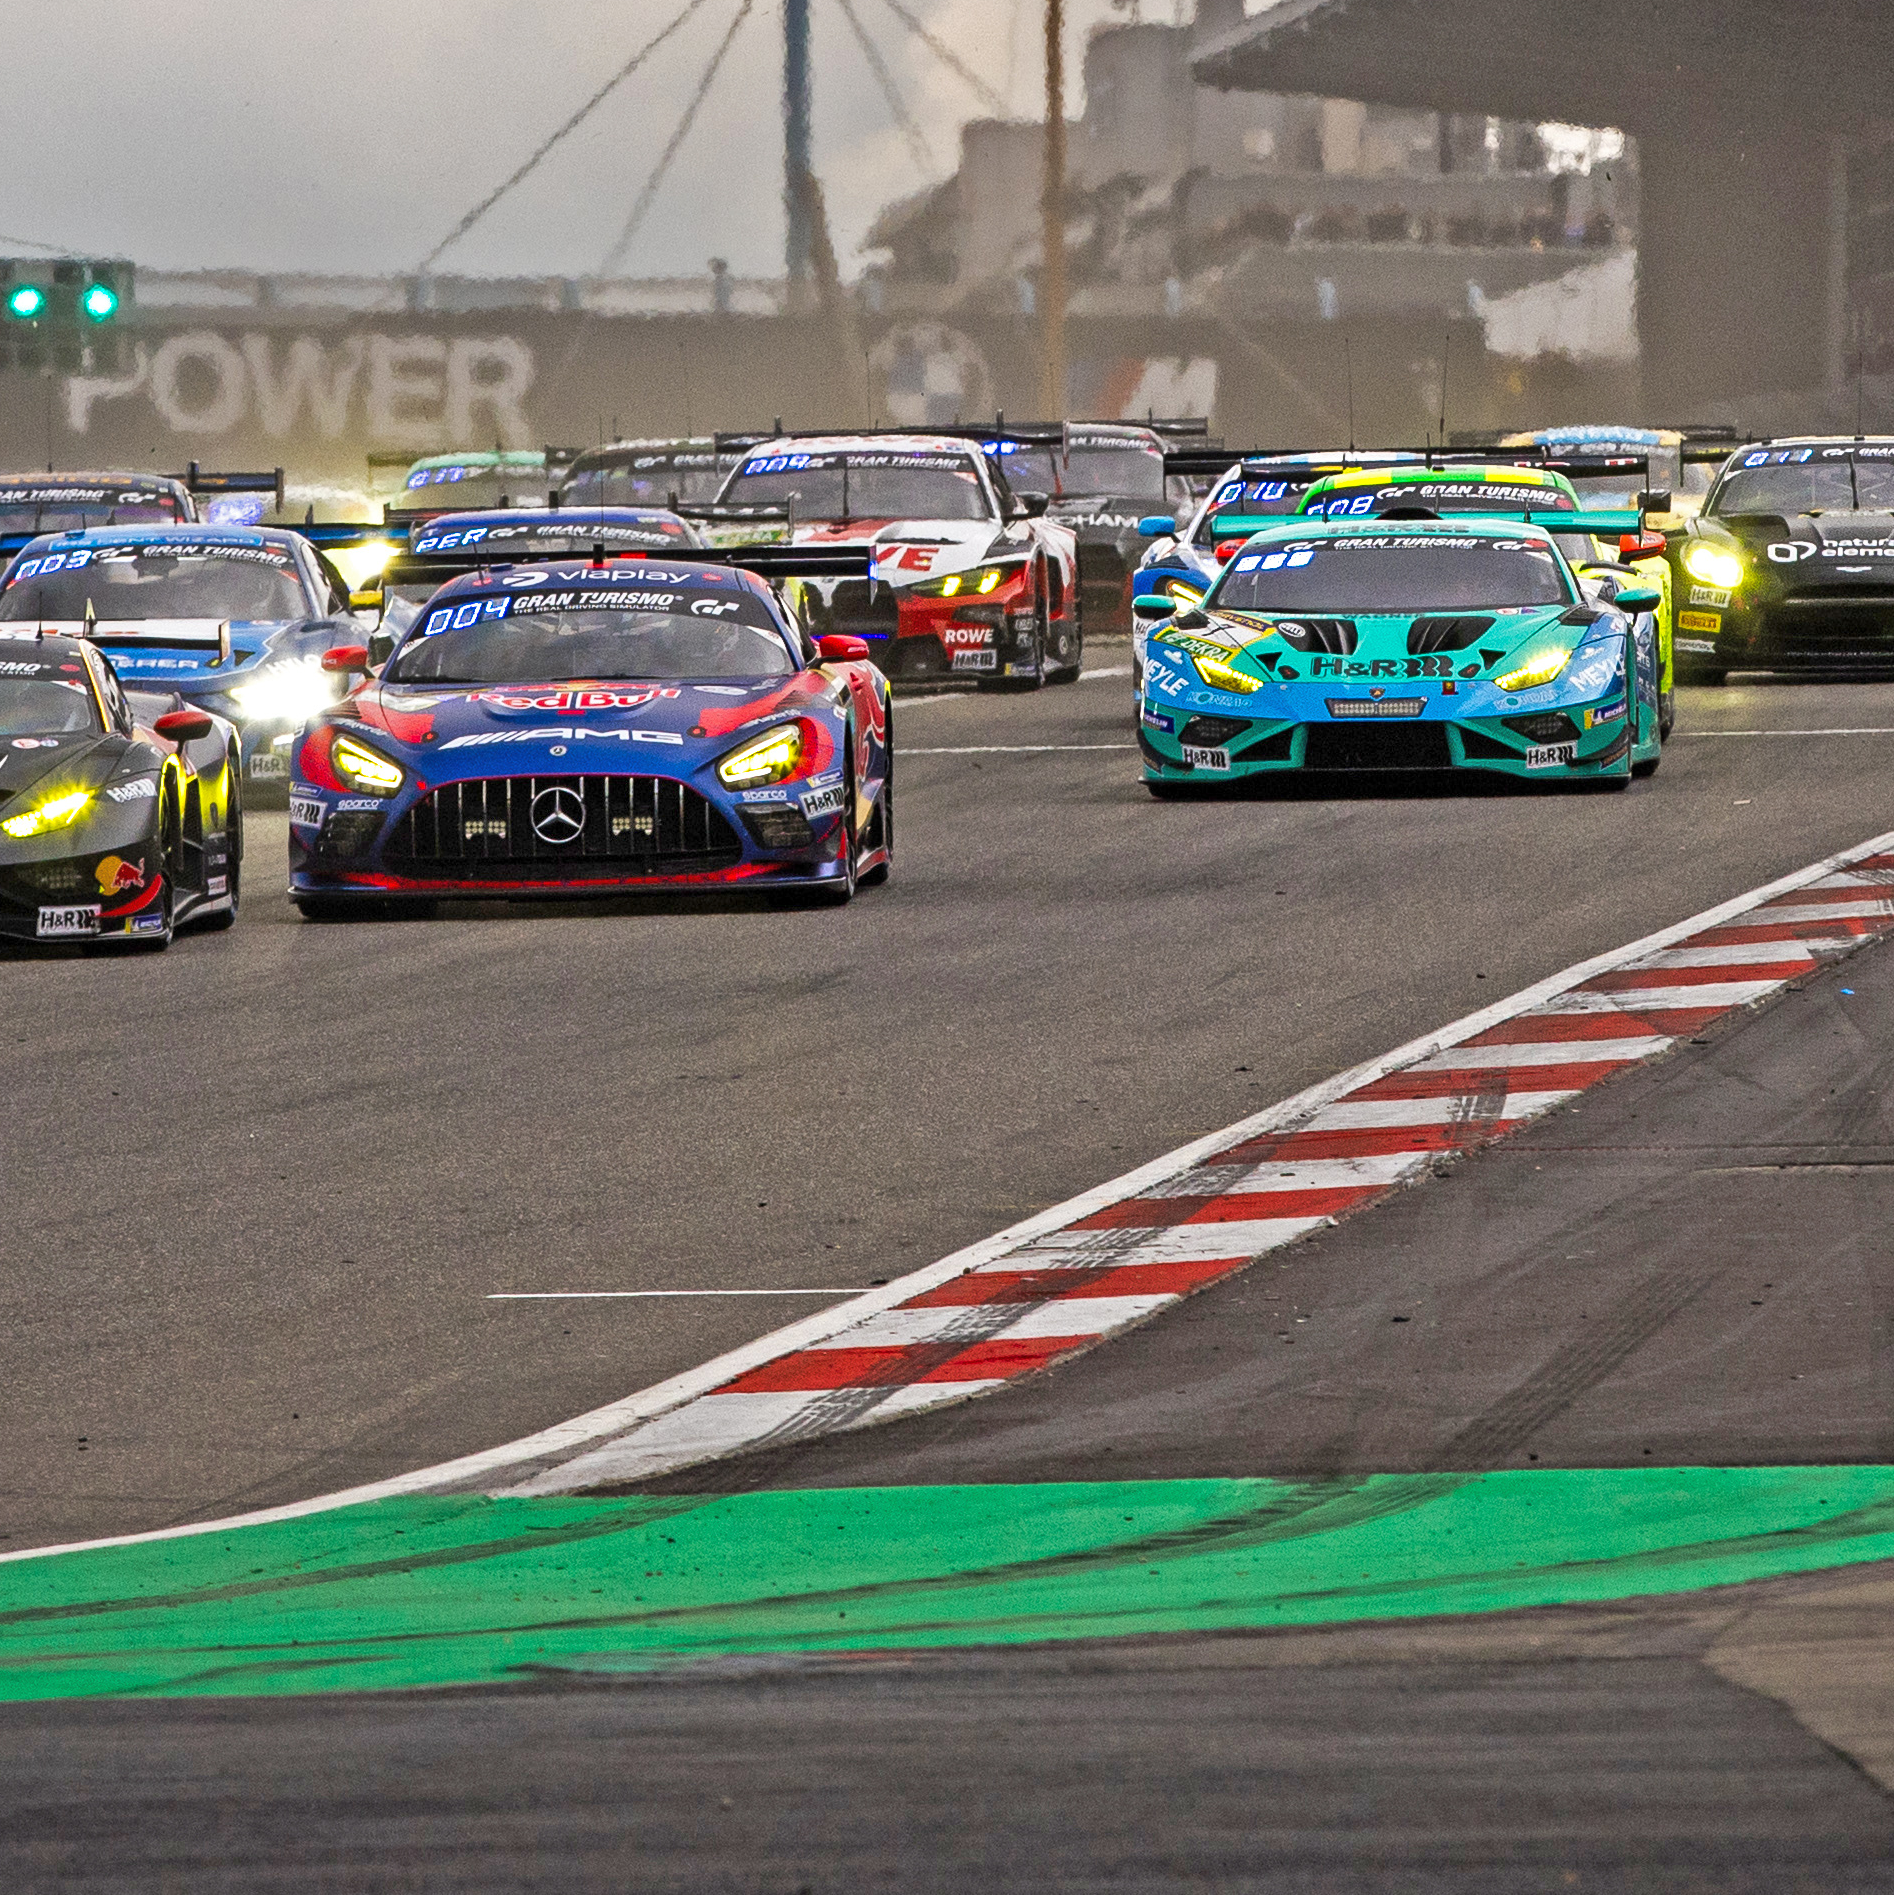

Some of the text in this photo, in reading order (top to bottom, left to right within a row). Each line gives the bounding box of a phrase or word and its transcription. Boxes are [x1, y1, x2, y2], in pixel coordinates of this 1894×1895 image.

[66, 329, 535, 443] POWER
[31, 489, 105, 501] TURISMO
[1421, 485, 1462, 496] GRAN
[1466, 485, 1559, 501] TURISMO
[1334, 539, 1380, 549] GRAN
[1385, 538, 1481, 548] TURISMO
[143, 545, 198, 556] GRAN
[202, 545, 288, 565] TURISMO
[558, 569, 690, 584] viaplay
[513, 593, 573, 610] GRAN
[579, 592, 676, 605] TURISMO
[609, 604, 670, 613] SIMULATOR
[945, 629, 994, 643] ROWE
[1182, 639, 1229, 663] DEKRA
[466, 688, 682, 710] Red Bull
[742, 790, 787, 801] sparco
[336, 798, 380, 810] sparco
